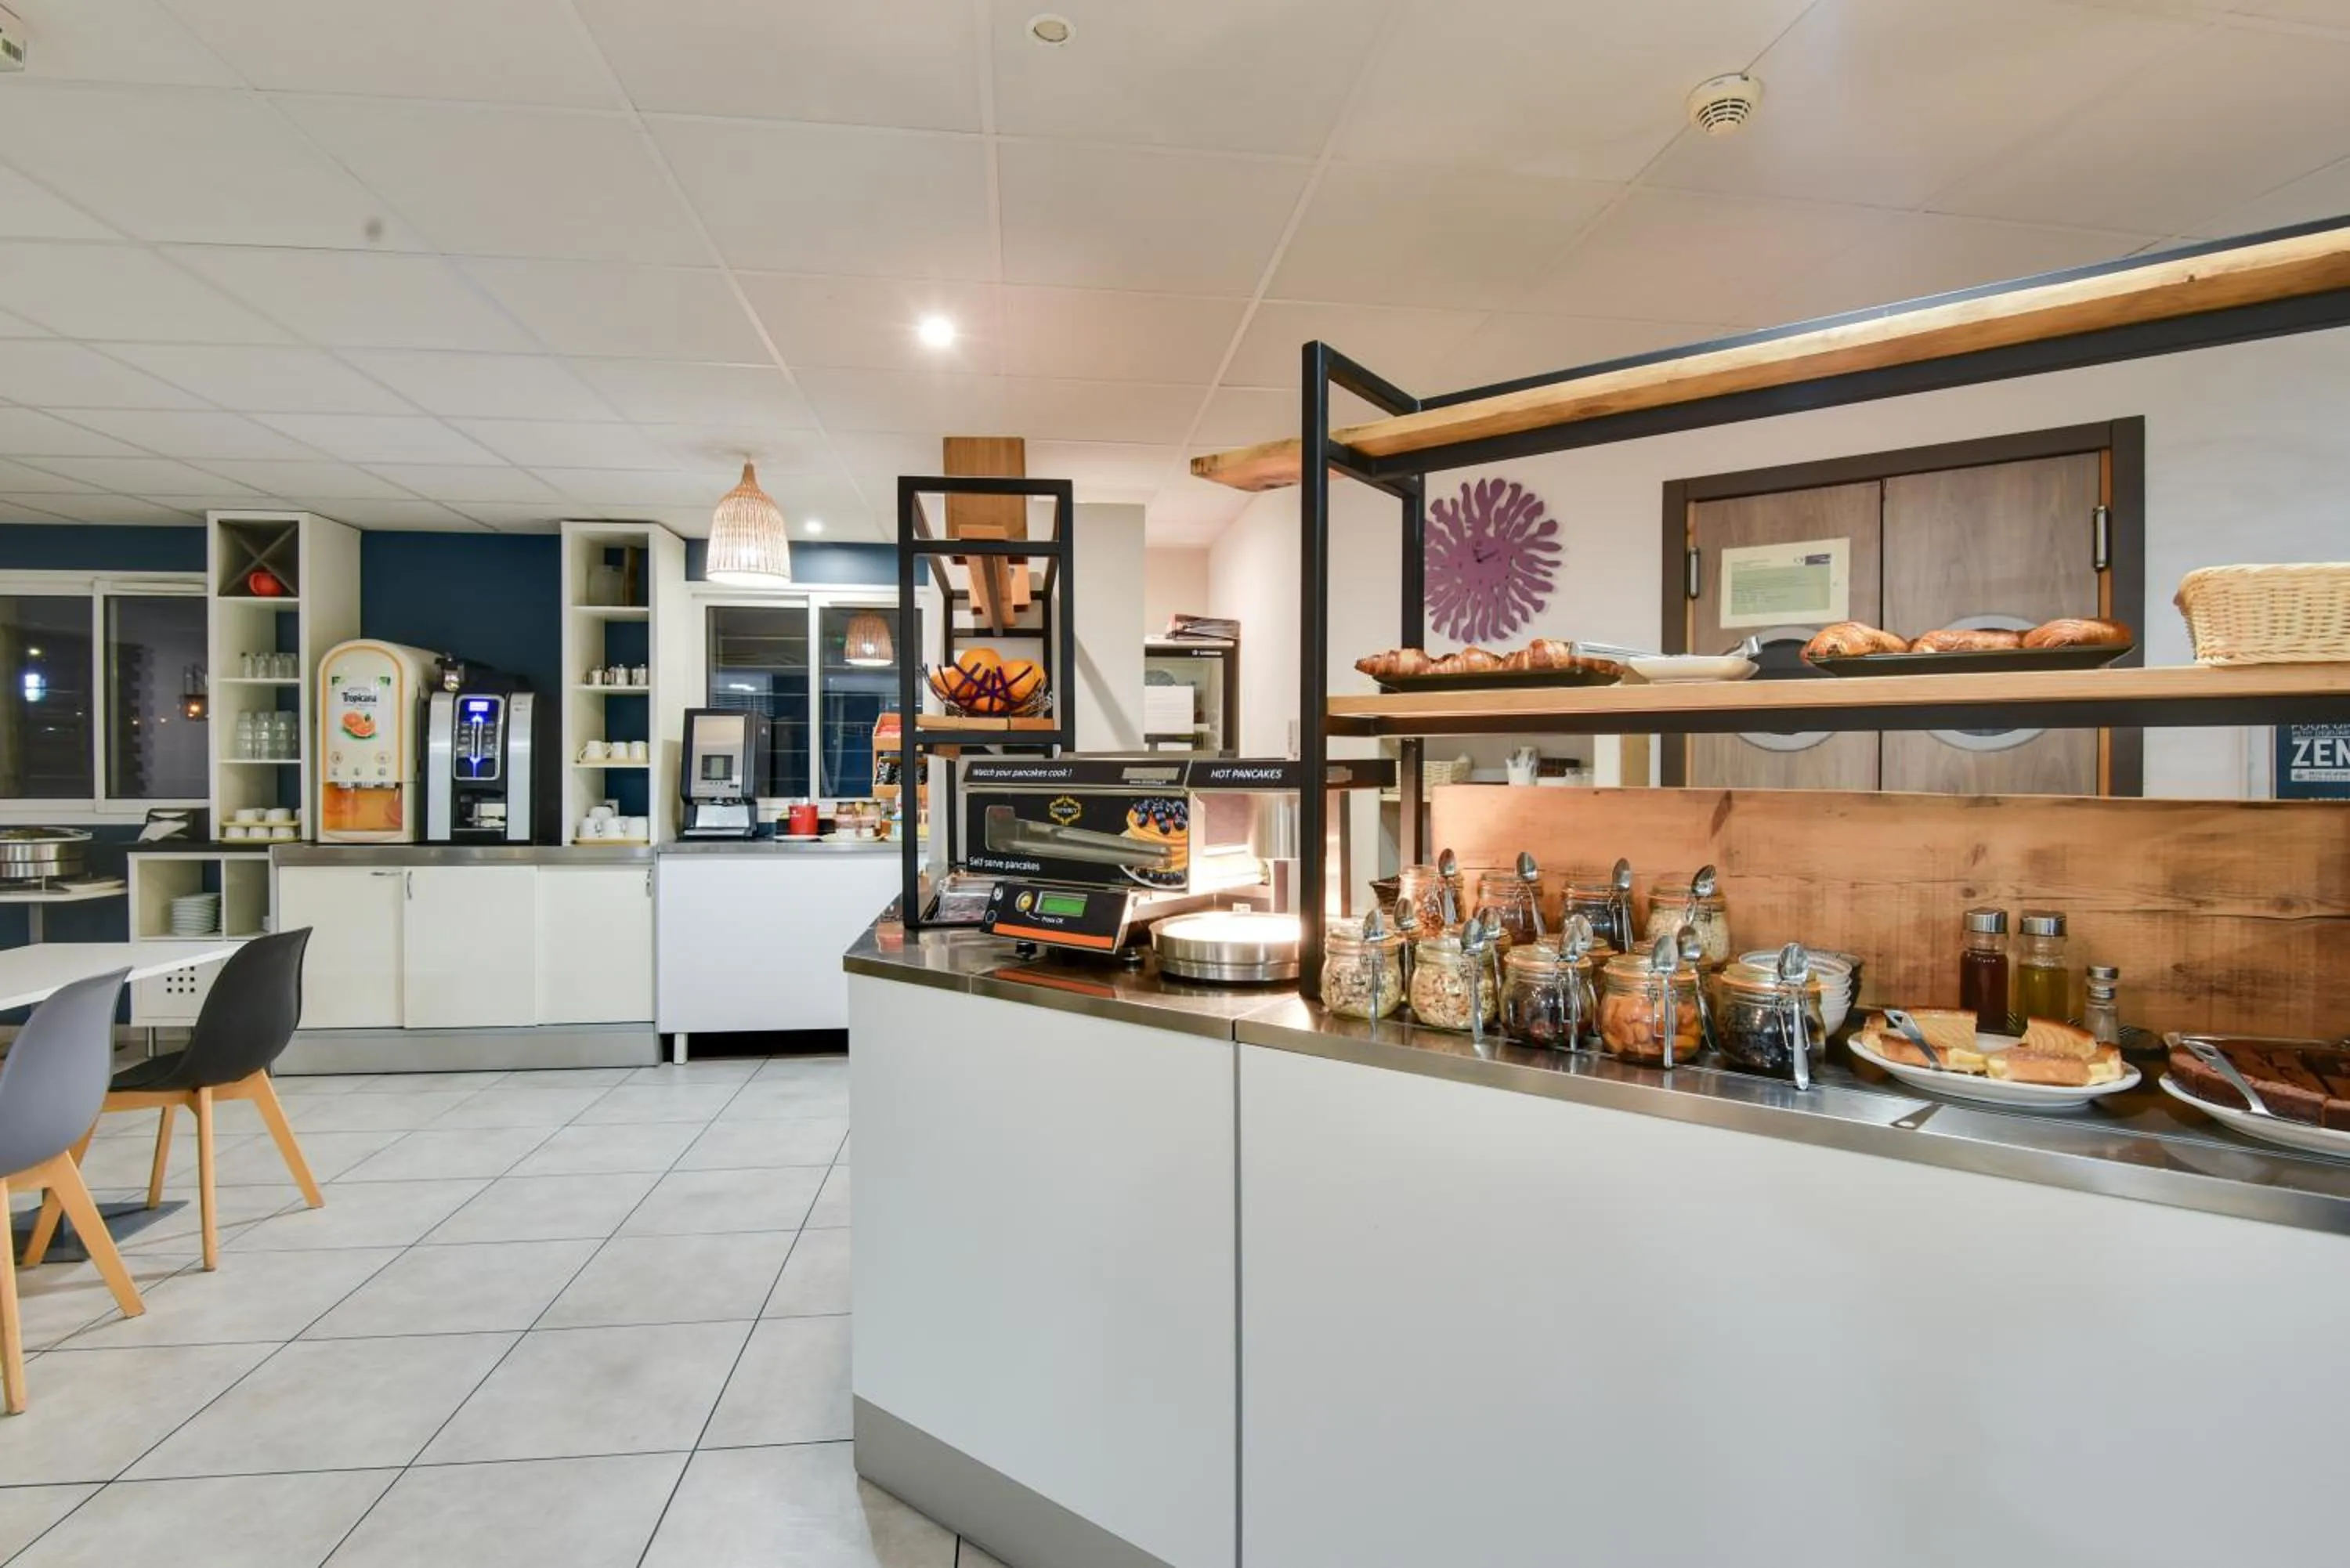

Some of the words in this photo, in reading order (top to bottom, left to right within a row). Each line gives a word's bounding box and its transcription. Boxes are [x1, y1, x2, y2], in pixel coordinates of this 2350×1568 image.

[341, 692, 377, 703] Tropicana
[2291, 739, 2350, 767] ZEN
[1011, 768, 1047, 778] pancakes
[1047, 768, 1067, 778] cook
[1210, 769, 1231, 779] HOT
[1232, 769, 1282, 779] PANCAKES
[1005, 859, 1041, 872] pancakes
